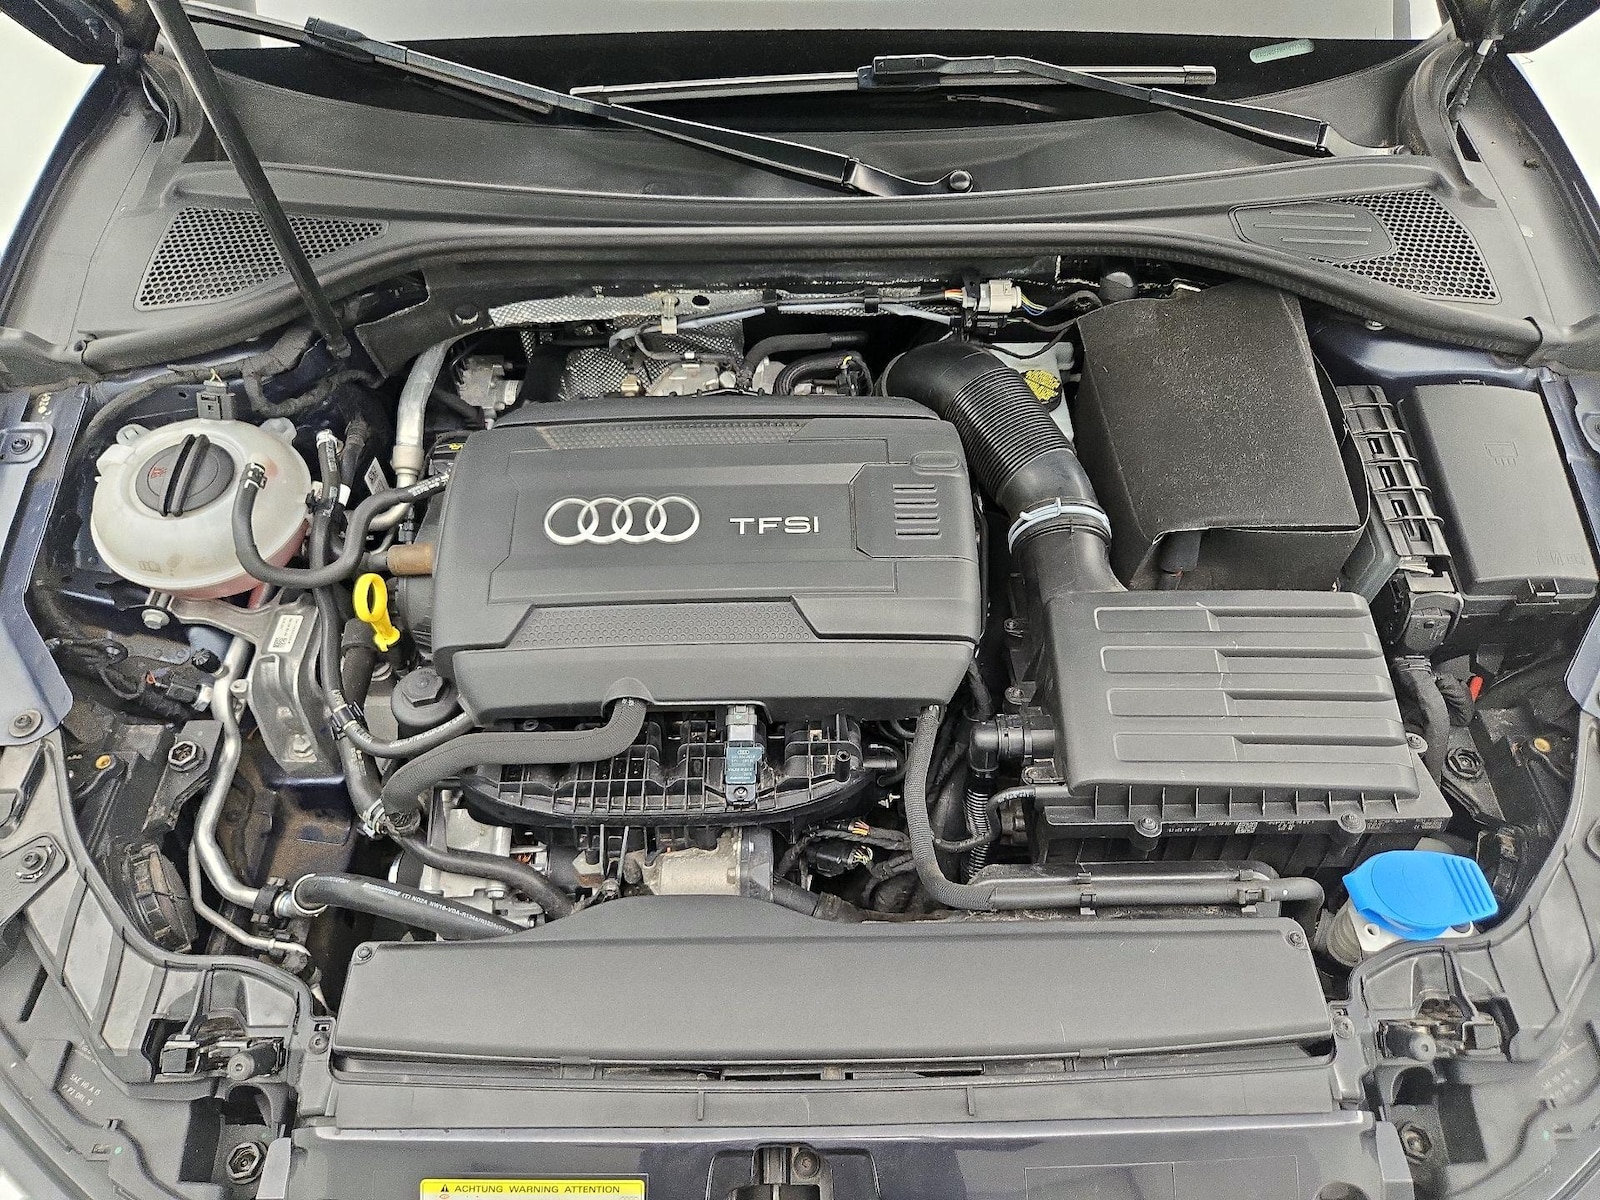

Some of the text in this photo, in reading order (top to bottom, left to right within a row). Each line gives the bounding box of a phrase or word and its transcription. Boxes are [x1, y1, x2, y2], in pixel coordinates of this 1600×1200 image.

[729, 516, 820, 535] TFSI
[454, 1185, 620, 1194] ACHTUNG WARNING ATTENTION
